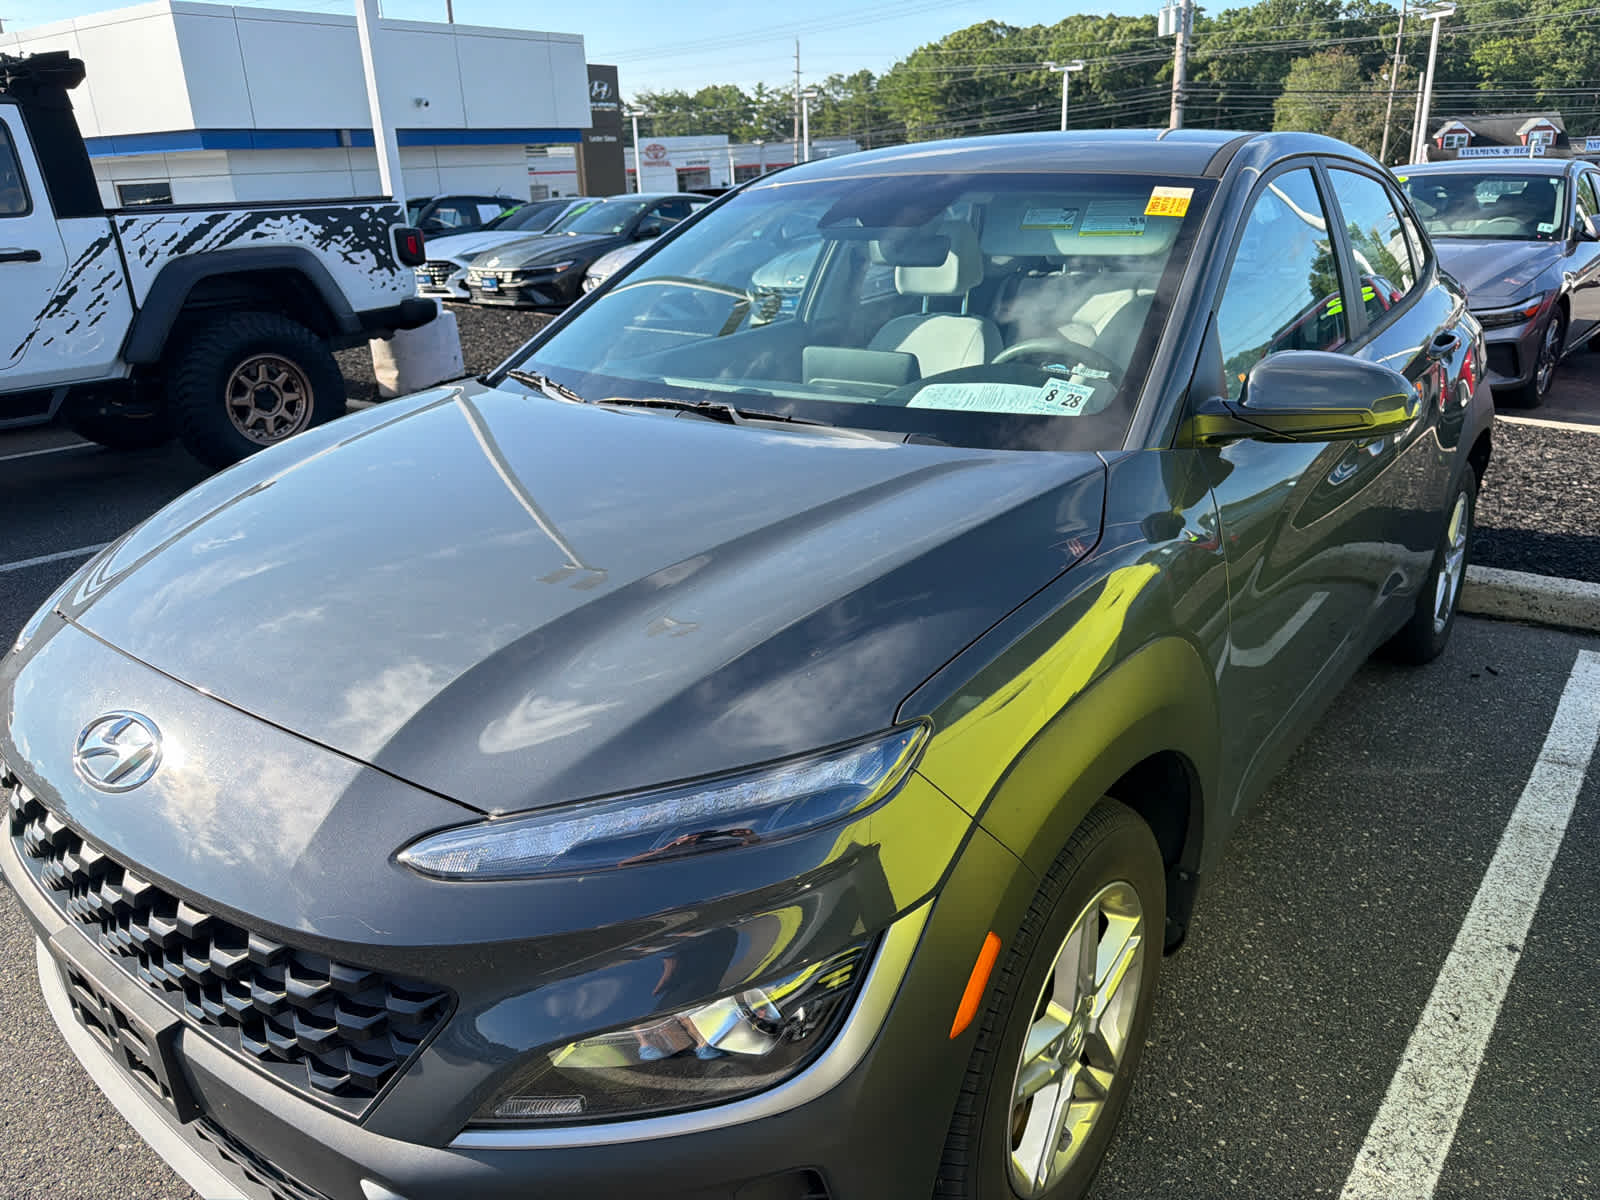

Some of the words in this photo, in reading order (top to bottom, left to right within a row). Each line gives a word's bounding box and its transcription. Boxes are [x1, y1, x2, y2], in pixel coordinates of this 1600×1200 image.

[1461, 147, 1500, 156] VITAMINS
[1502, 147, 1511, 155] &
[1513, 146, 1543, 155] HERS
[1045, 389, 1059, 402] 8
[1061, 393, 1083, 408] 28
